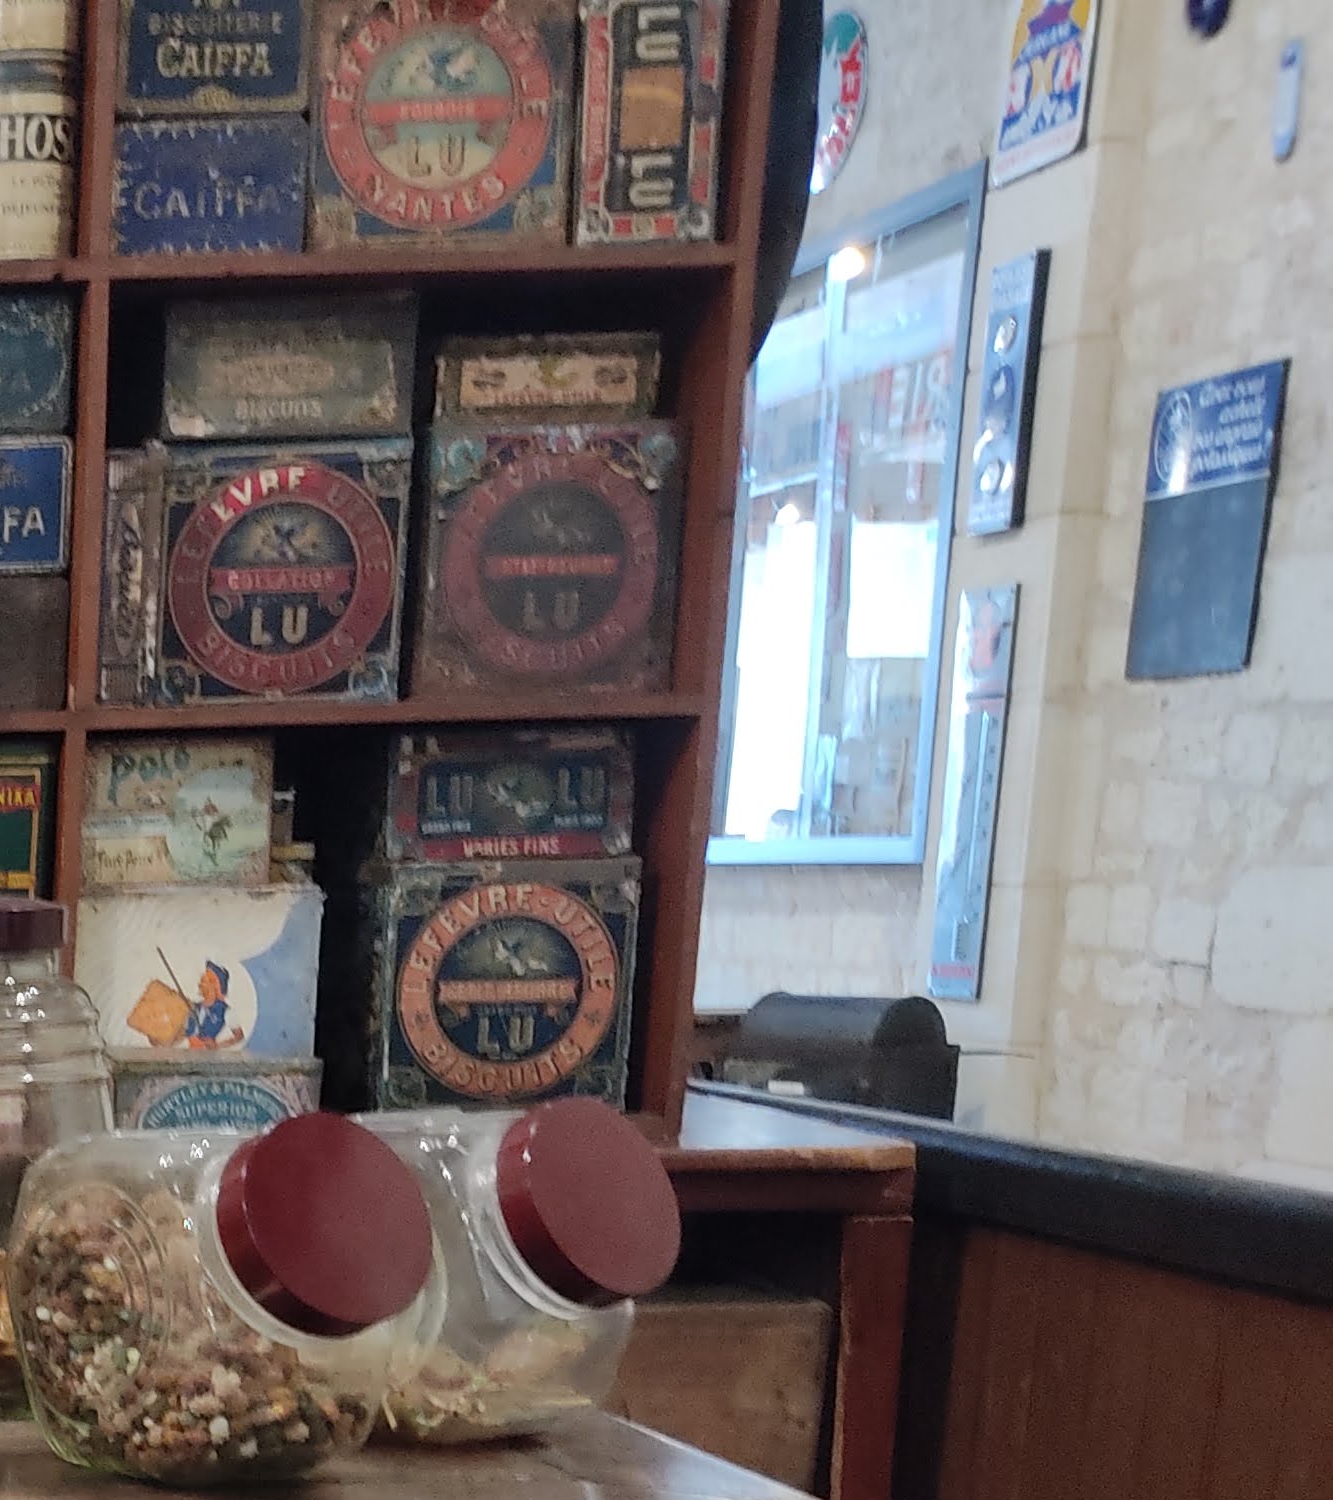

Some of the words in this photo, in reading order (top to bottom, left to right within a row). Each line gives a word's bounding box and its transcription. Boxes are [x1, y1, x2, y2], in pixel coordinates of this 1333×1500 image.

[405, 137, 465, 177] LU
[250, 606, 309, 645] LU
[476, 1015, 535, 1059] LU
